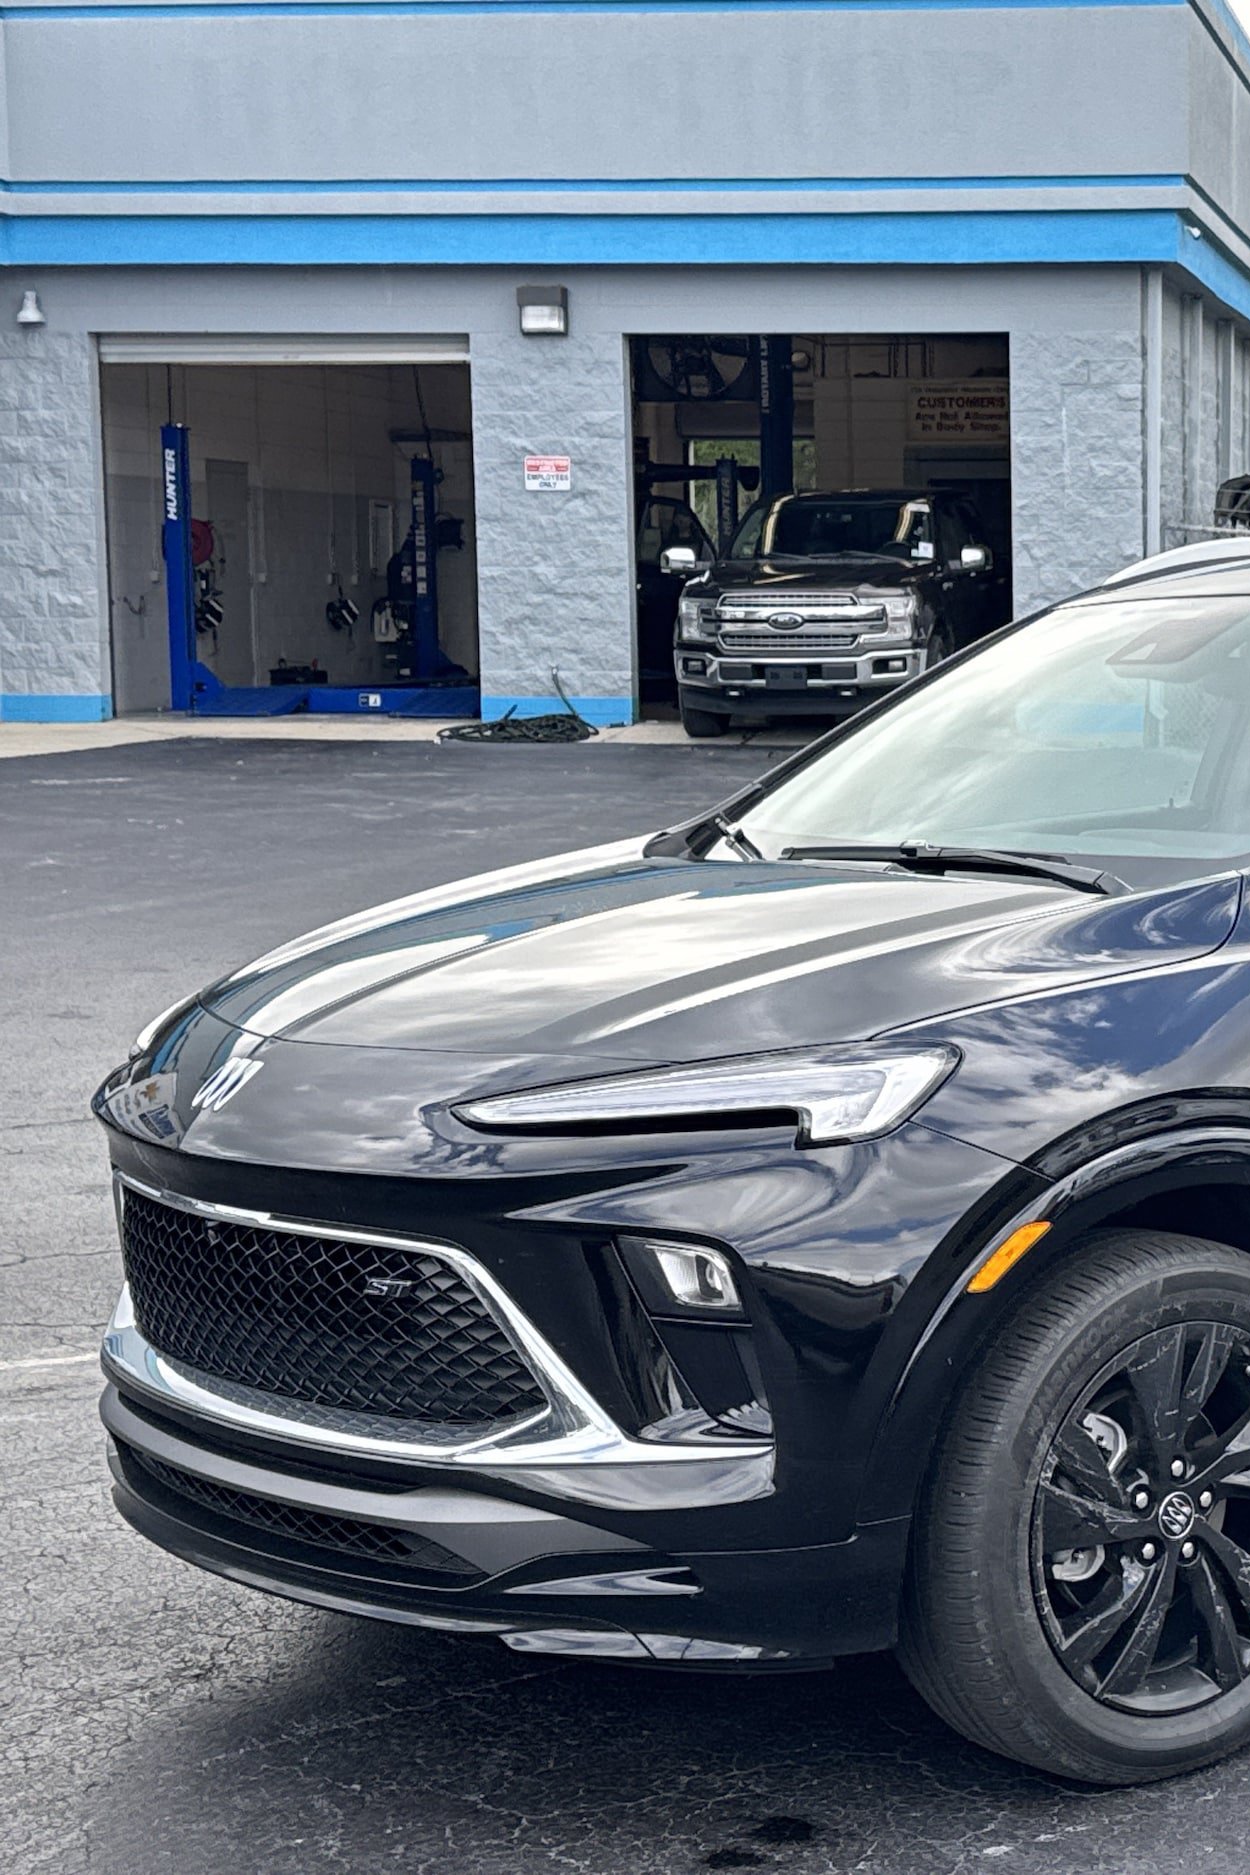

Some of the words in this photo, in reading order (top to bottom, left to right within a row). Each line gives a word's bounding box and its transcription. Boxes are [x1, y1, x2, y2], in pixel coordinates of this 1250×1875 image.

[917, 396, 1006, 409] CUSTOMERS
[164, 447, 178, 521] HUNTER
[720, 477, 733, 537] HUNTER
[363, 1278, 412, 1298] ST
